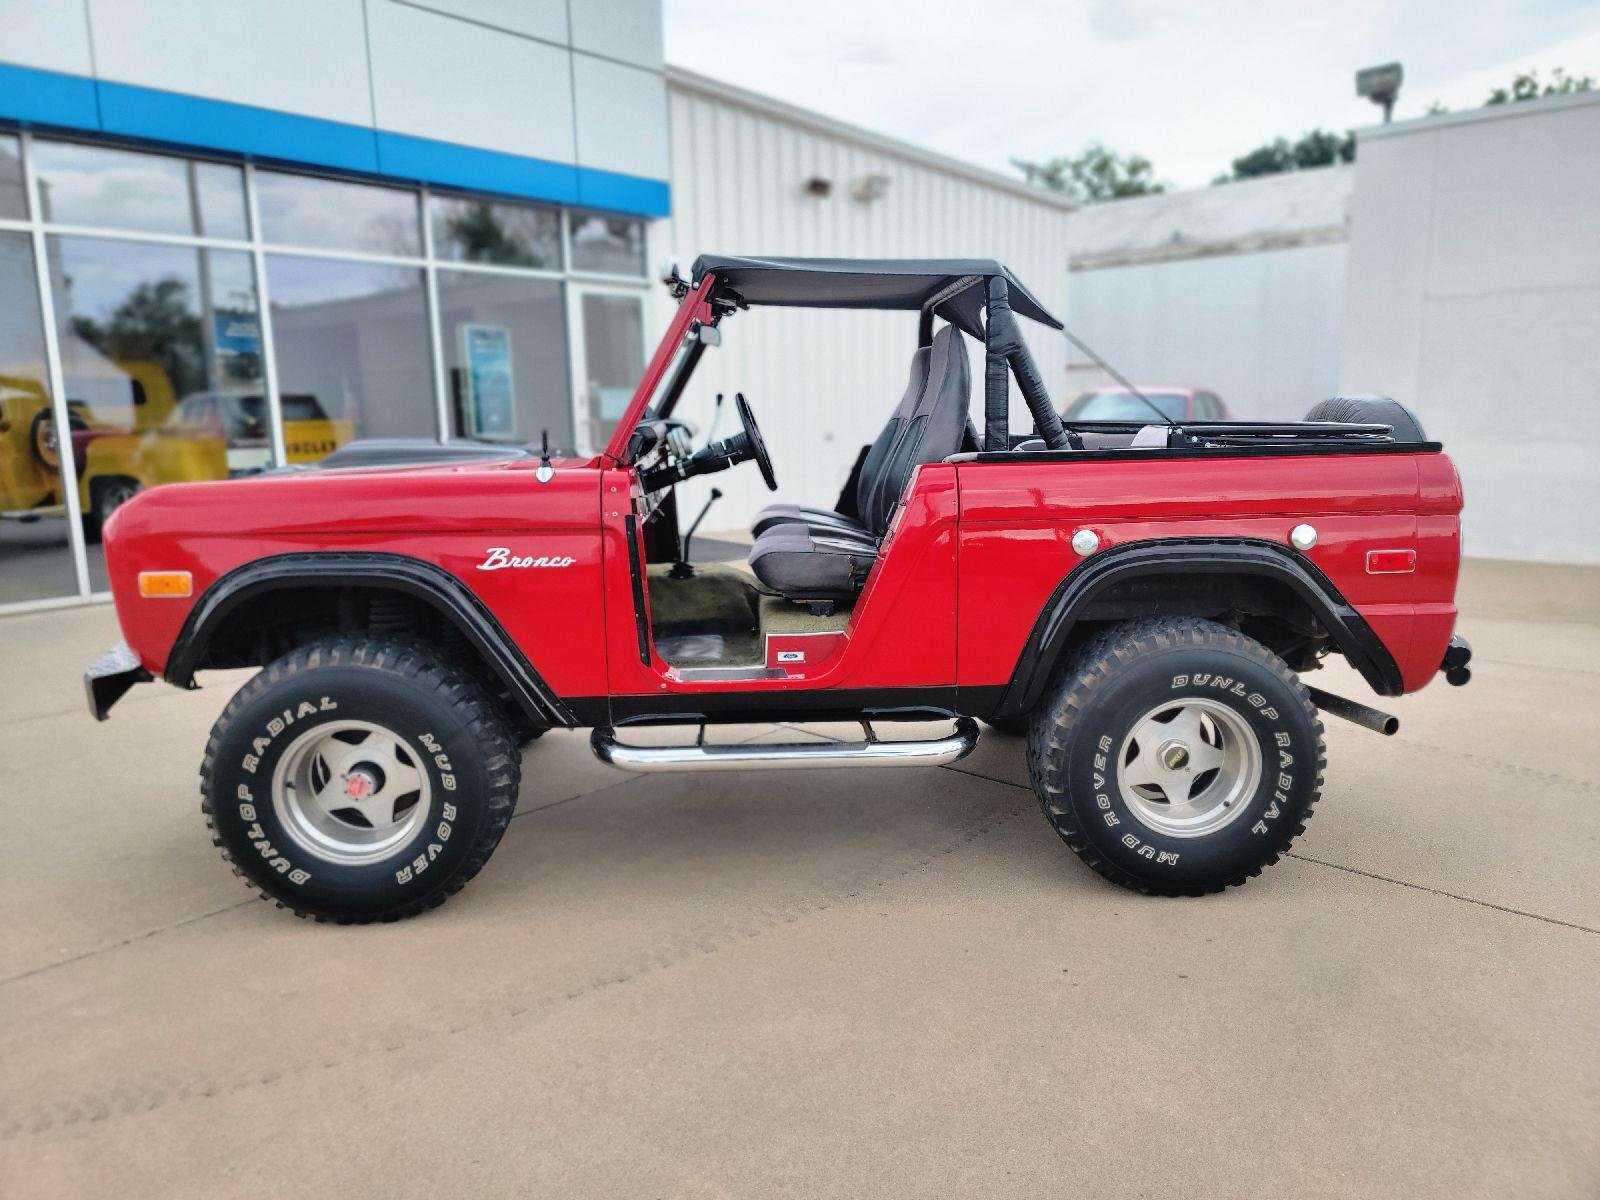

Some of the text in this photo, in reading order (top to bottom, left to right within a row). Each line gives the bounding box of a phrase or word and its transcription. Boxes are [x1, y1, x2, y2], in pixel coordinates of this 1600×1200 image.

[476, 547, 576, 571] Bronco
[238, 697, 337, 884] DUNLOP RADIAL
[396, 733, 456, 884] MUD ROVER
[1093, 735, 1180, 866] MUD ROVER
[1172, 674, 1293, 835] DUNLOP RADIAL
